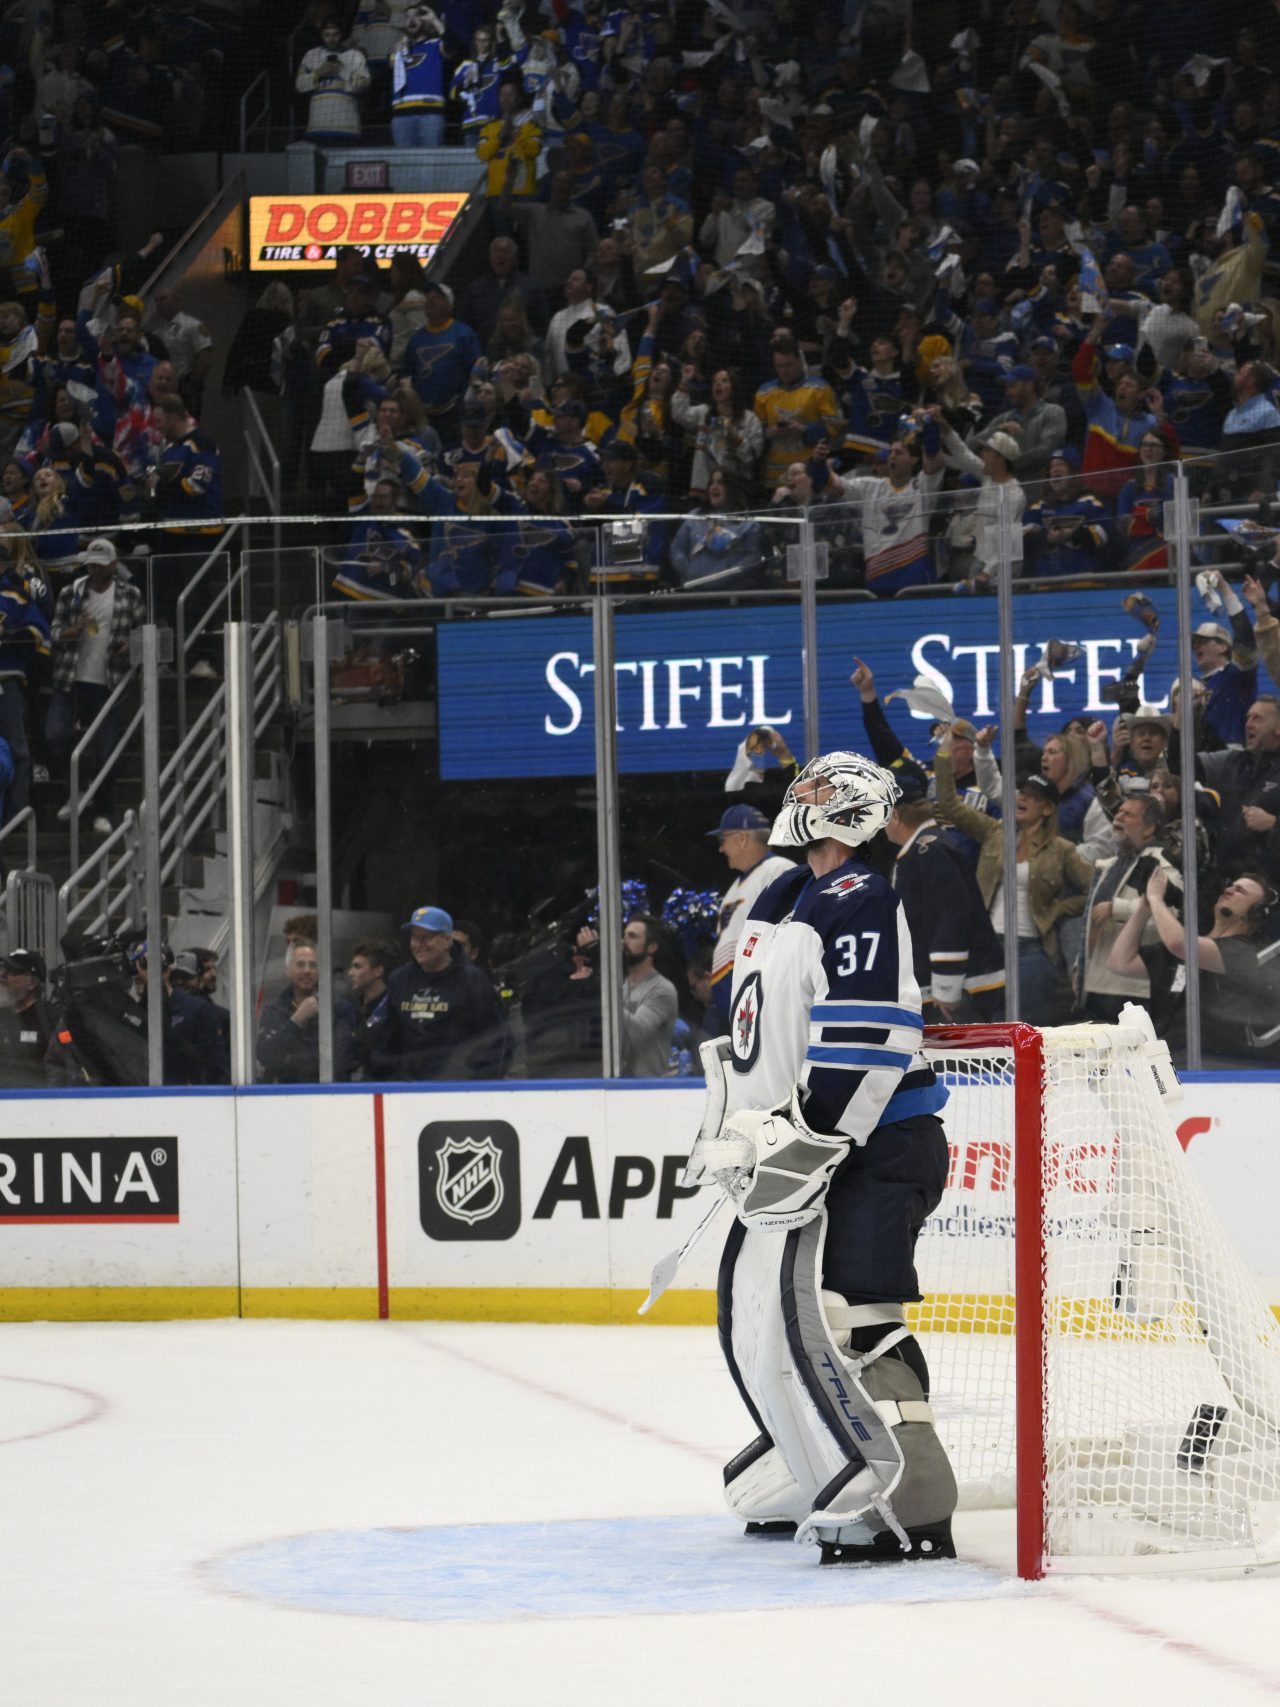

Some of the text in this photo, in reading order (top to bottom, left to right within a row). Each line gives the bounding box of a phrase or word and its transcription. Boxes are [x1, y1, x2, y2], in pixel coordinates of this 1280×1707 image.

[353, 166, 382, 185] EXIT
[265, 201, 460, 243] DOBBS
[264, 246, 303, 259] TIRE
[835, 931, 881, 977] 37
[451, 1157, 491, 1206] NHL
[821, 1351, 873, 1442] TRUE
